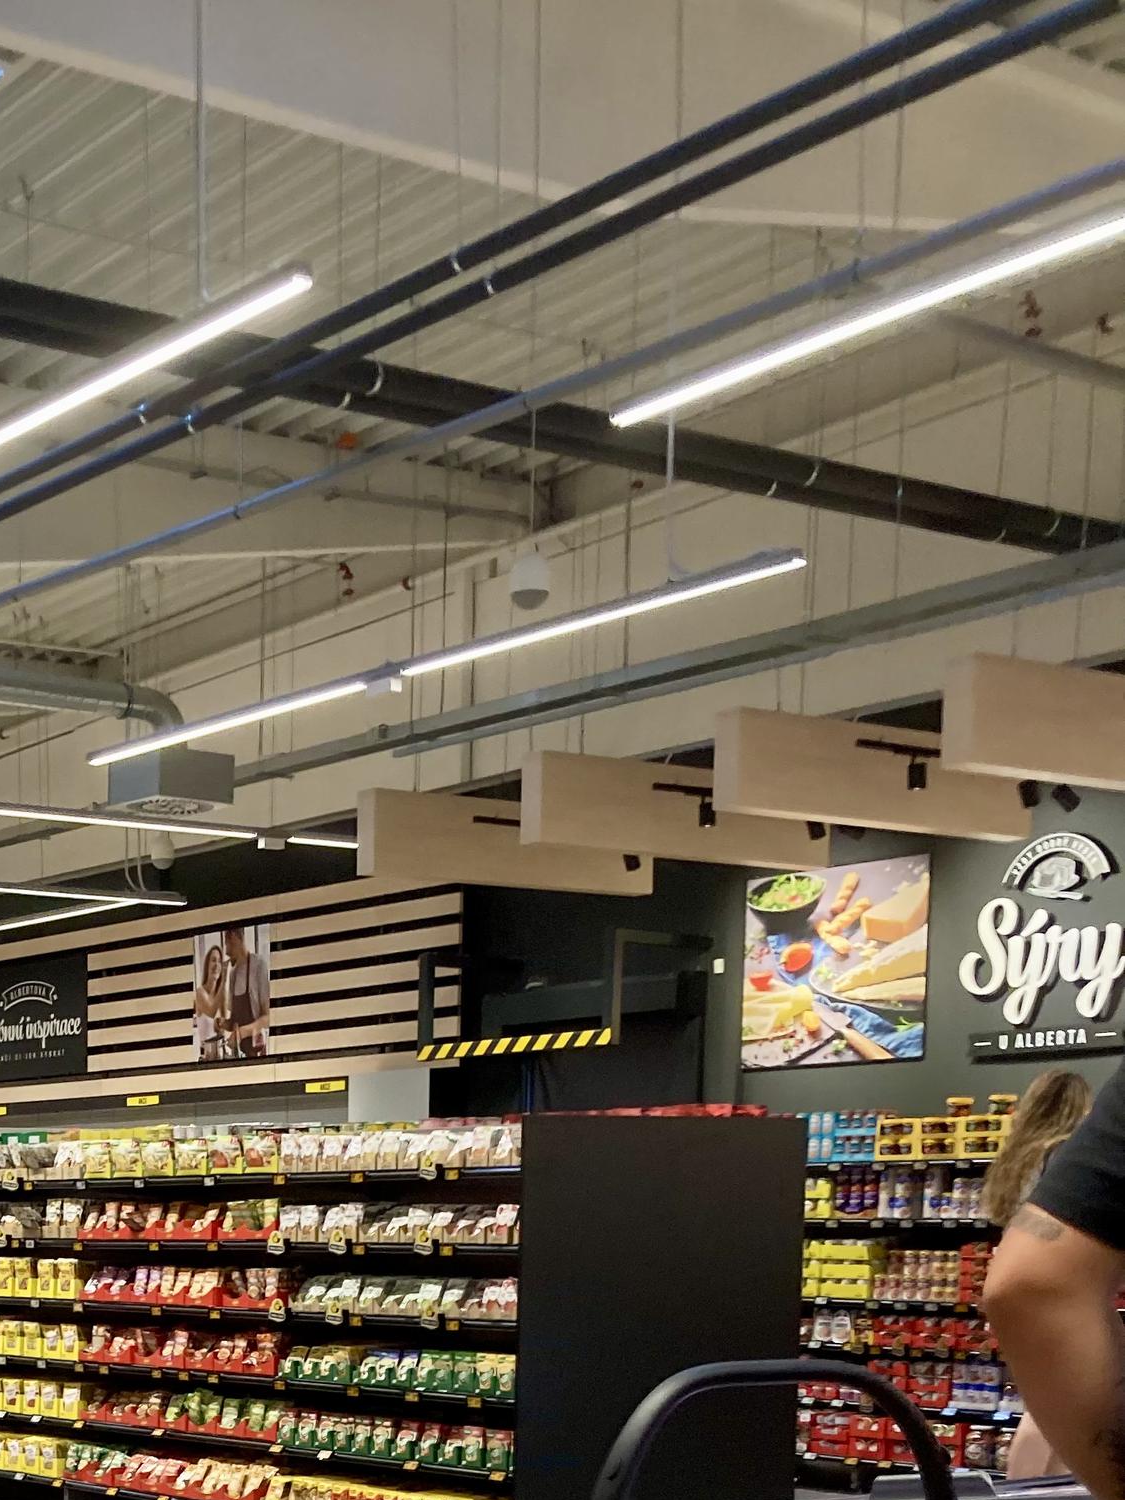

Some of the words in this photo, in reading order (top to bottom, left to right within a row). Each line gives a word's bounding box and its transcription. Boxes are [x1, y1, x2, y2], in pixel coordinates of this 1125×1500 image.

[959, 897, 1125, 1025] Sýry
[10, 985, 47, 1001] ALBERTOVA
[26, 1013, 82, 1049] inspirace
[998, 1034, 1009, 1049] U
[1014, 1028, 1087, 1048] ALBERTA
